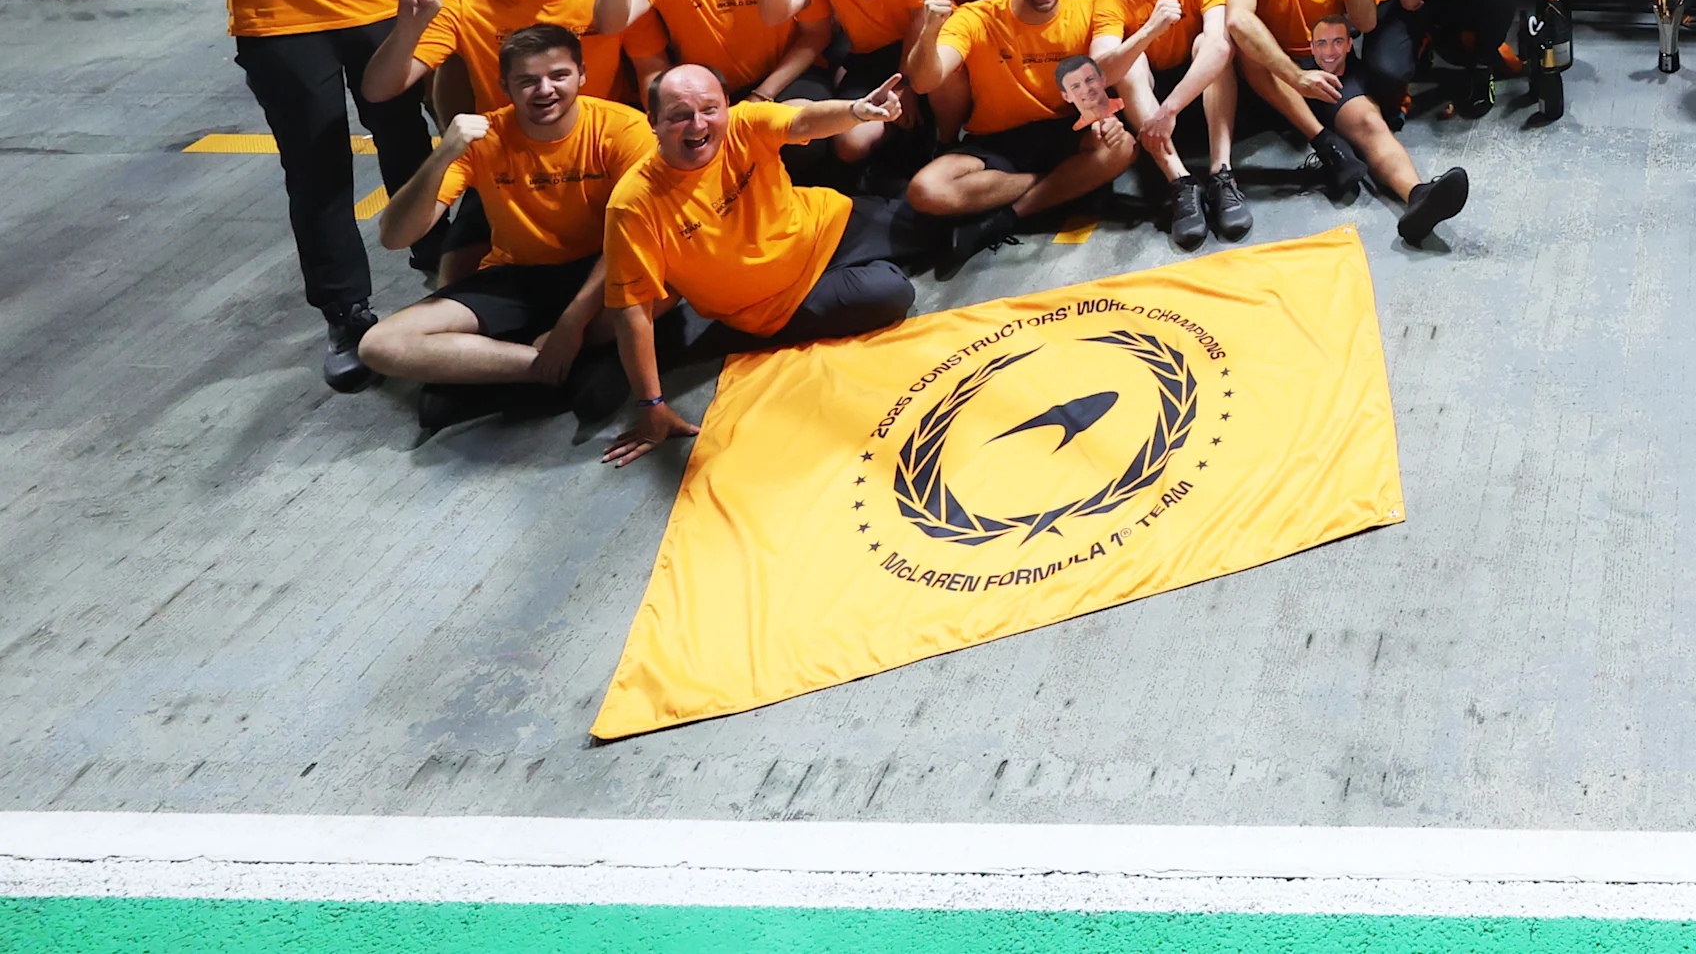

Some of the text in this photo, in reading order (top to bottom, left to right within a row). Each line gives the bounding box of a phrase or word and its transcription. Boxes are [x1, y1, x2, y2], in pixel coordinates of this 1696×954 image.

[870, 298, 1227, 439] 2025 CONSTRUCTORS' WORLD CHAMPIONS
[880, 551, 981, 593] McLAREN
[984, 540, 1107, 592] FORMULA
[1136, 479, 1195, 528] TEAM
